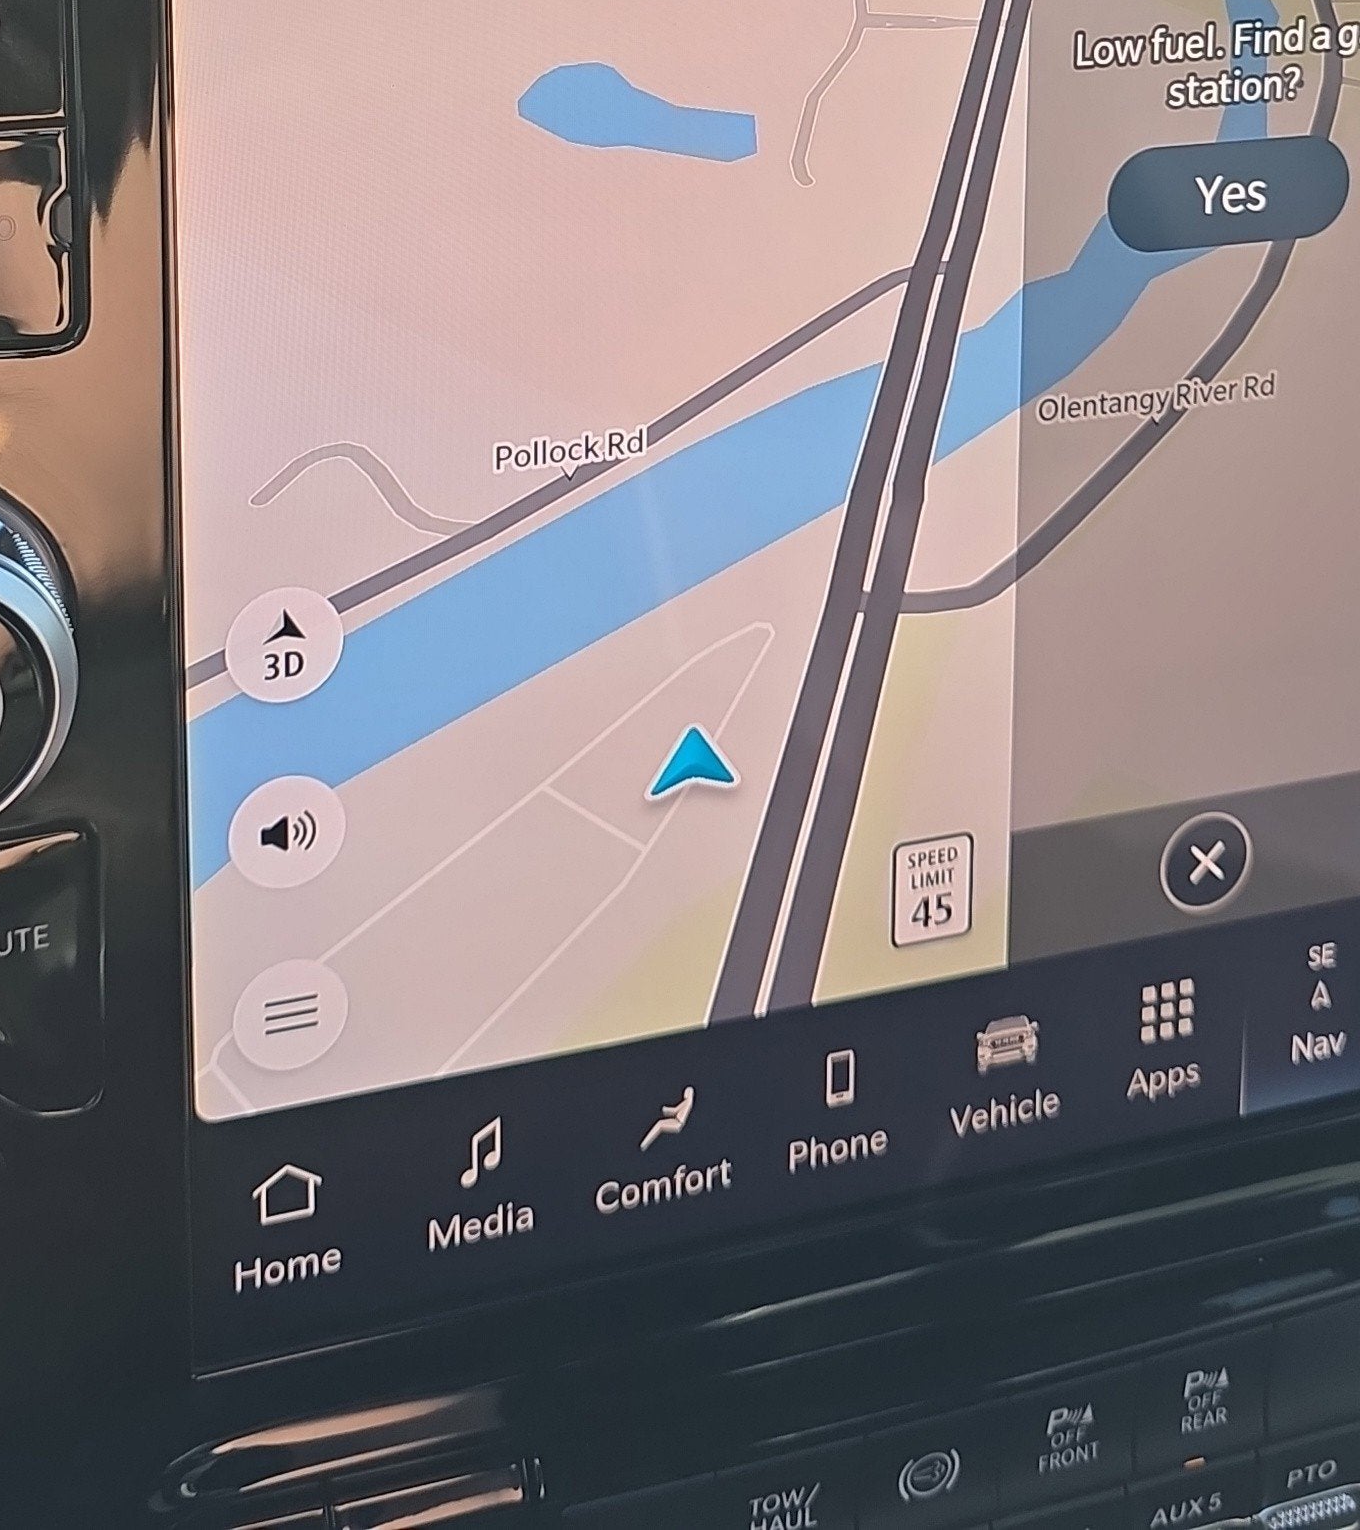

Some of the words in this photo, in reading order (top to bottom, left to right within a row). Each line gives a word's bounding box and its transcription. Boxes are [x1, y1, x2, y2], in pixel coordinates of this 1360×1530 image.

[1074, 33, 1145, 68] Low
[1151, 25, 1225, 64] fuel.
[1233, 18, 1304, 57] Find
[1312, 26, 1332, 51] a
[1166, 67, 1303, 109] station?
[1194, 174, 1268, 216] Yes
[1038, 388, 1170, 424] Olentangy
[1175, 381, 1238, 406] River
[1243, 373, 1276, 398] Rd
[494, 432, 600, 471] Pollock
[608, 428, 644, 455] Rd
[263, 650, 304, 681] 3D
[907, 845, 959, 870] SPEED
[910, 867, 955, 891] LIMIT
[911, 891, 953, 928] 45
[1307, 941, 1338, 971] SE
[1291, 1030, 1348, 1066] Nav
[1126, 1060, 1201, 1102] Apps
[949, 1088, 1061, 1138] Vehicle
[788, 1128, 888, 1175] Phone
[595, 1157, 732, 1215] Comfort
[427, 1201, 535, 1251] Media
[233, 1244, 342, 1293] Home
[1181, 1406, 1228, 1434] REAR
[1187, 1391, 1222, 1413] OFF
[1050, 1425, 1086, 1449] OFF
[1038, 1440, 1100, 1474] FRONT
[1287, 1459, 1338, 1489] PTO
[748, 1482, 821, 1517] TOW/
[1150, 1497, 1205, 1529] AUX
[1208, 1492, 1223, 1512] 5
